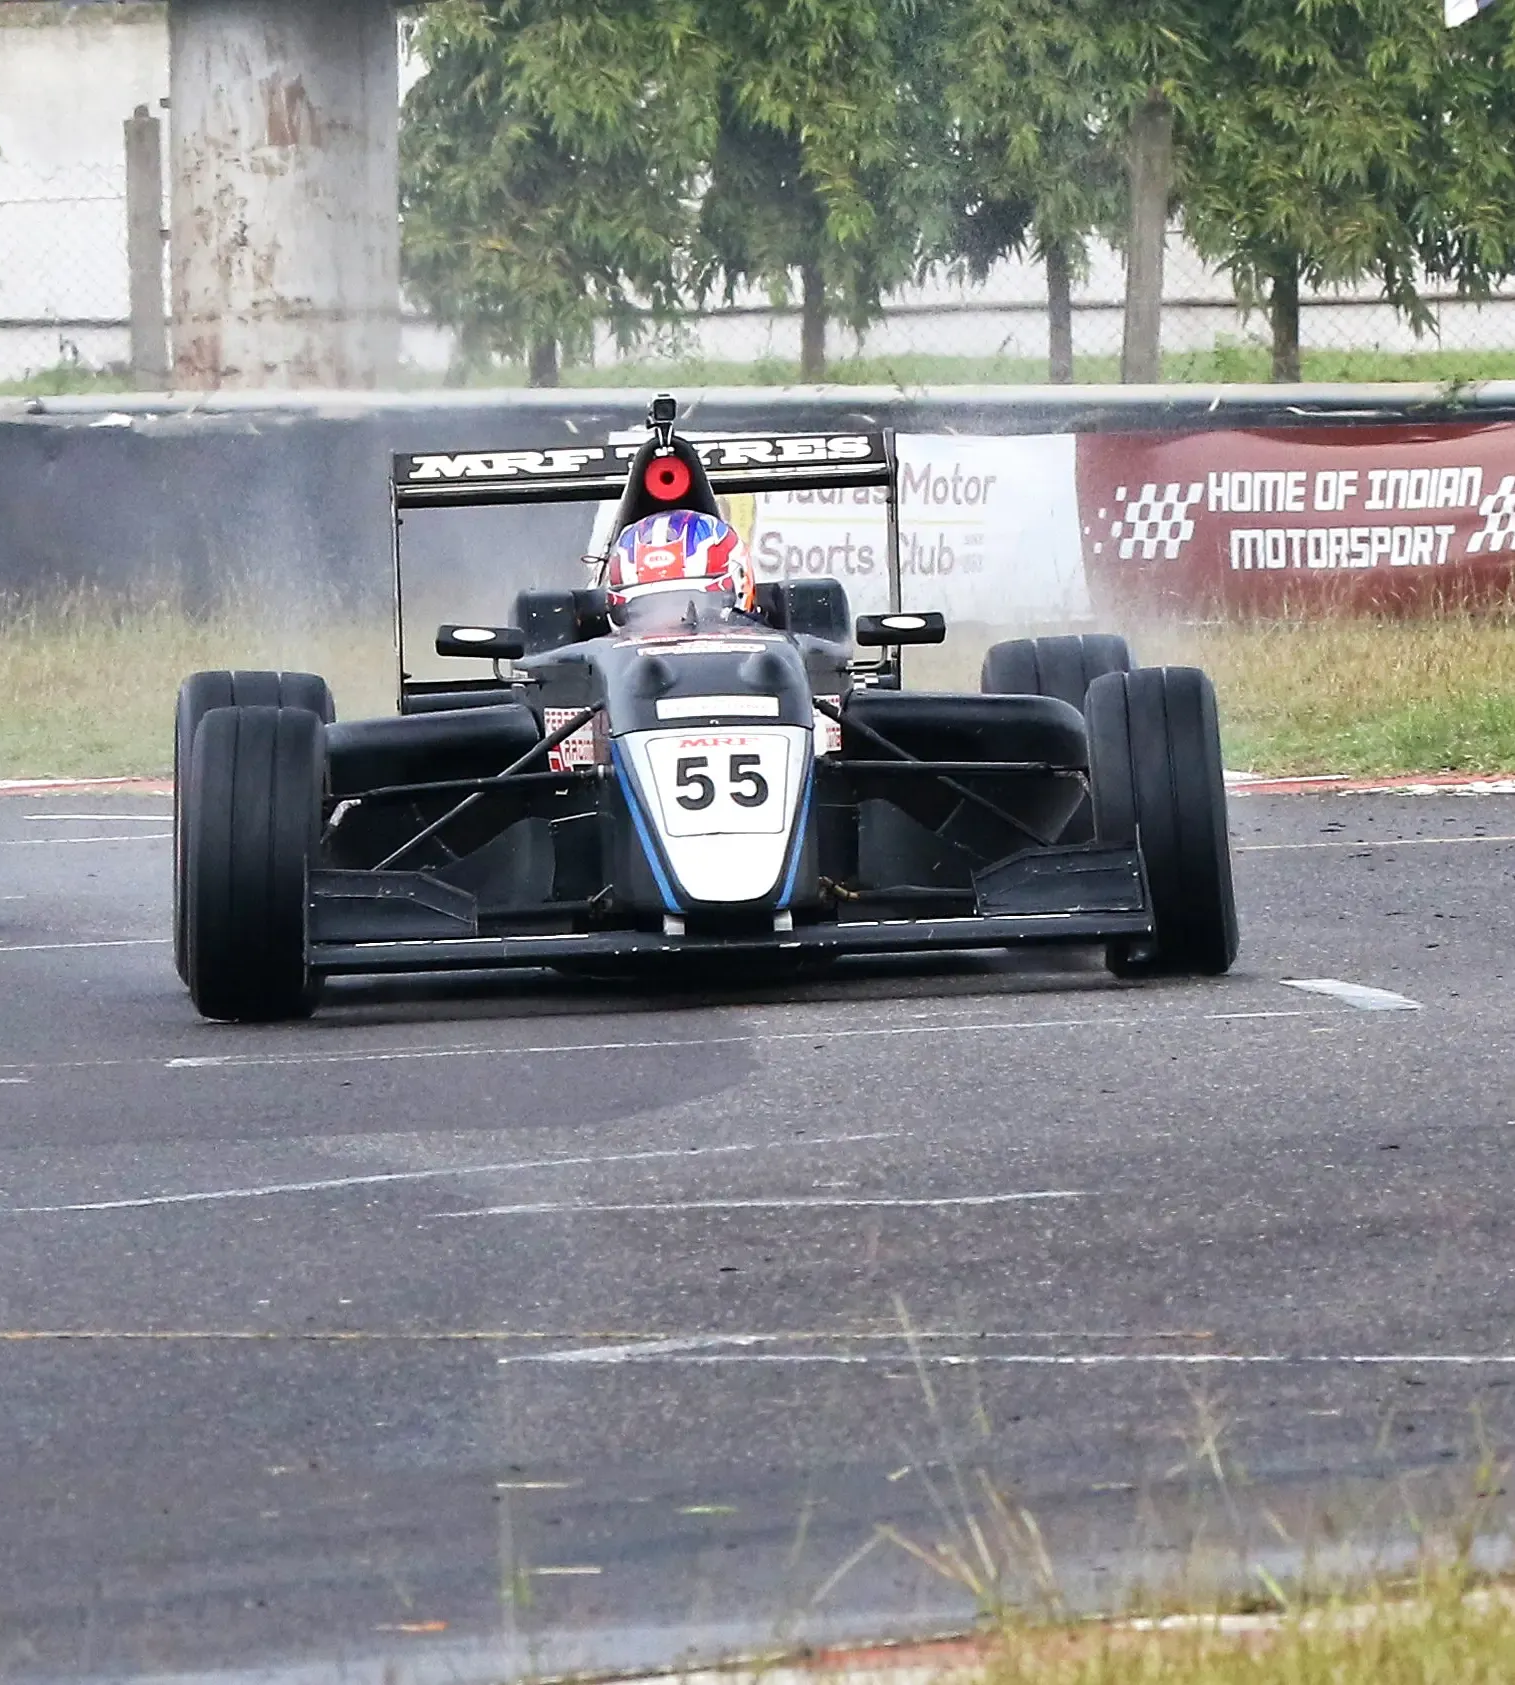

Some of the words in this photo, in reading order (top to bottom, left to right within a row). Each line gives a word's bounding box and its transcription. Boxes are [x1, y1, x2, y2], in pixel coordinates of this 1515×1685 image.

[408, 445, 606, 479] MRF
[901, 462, 996, 505] Motor
[1207, 471, 1307, 512] HOME
[1314, 470, 1359, 511] OF
[1364, 467, 1482, 510] INDIAN
[758, 531, 874, 579] Sports
[1230, 524, 1456, 570] MOTORSPORT
[678, 737, 761, 748] MRF
[676, 754, 769, 810] 55
